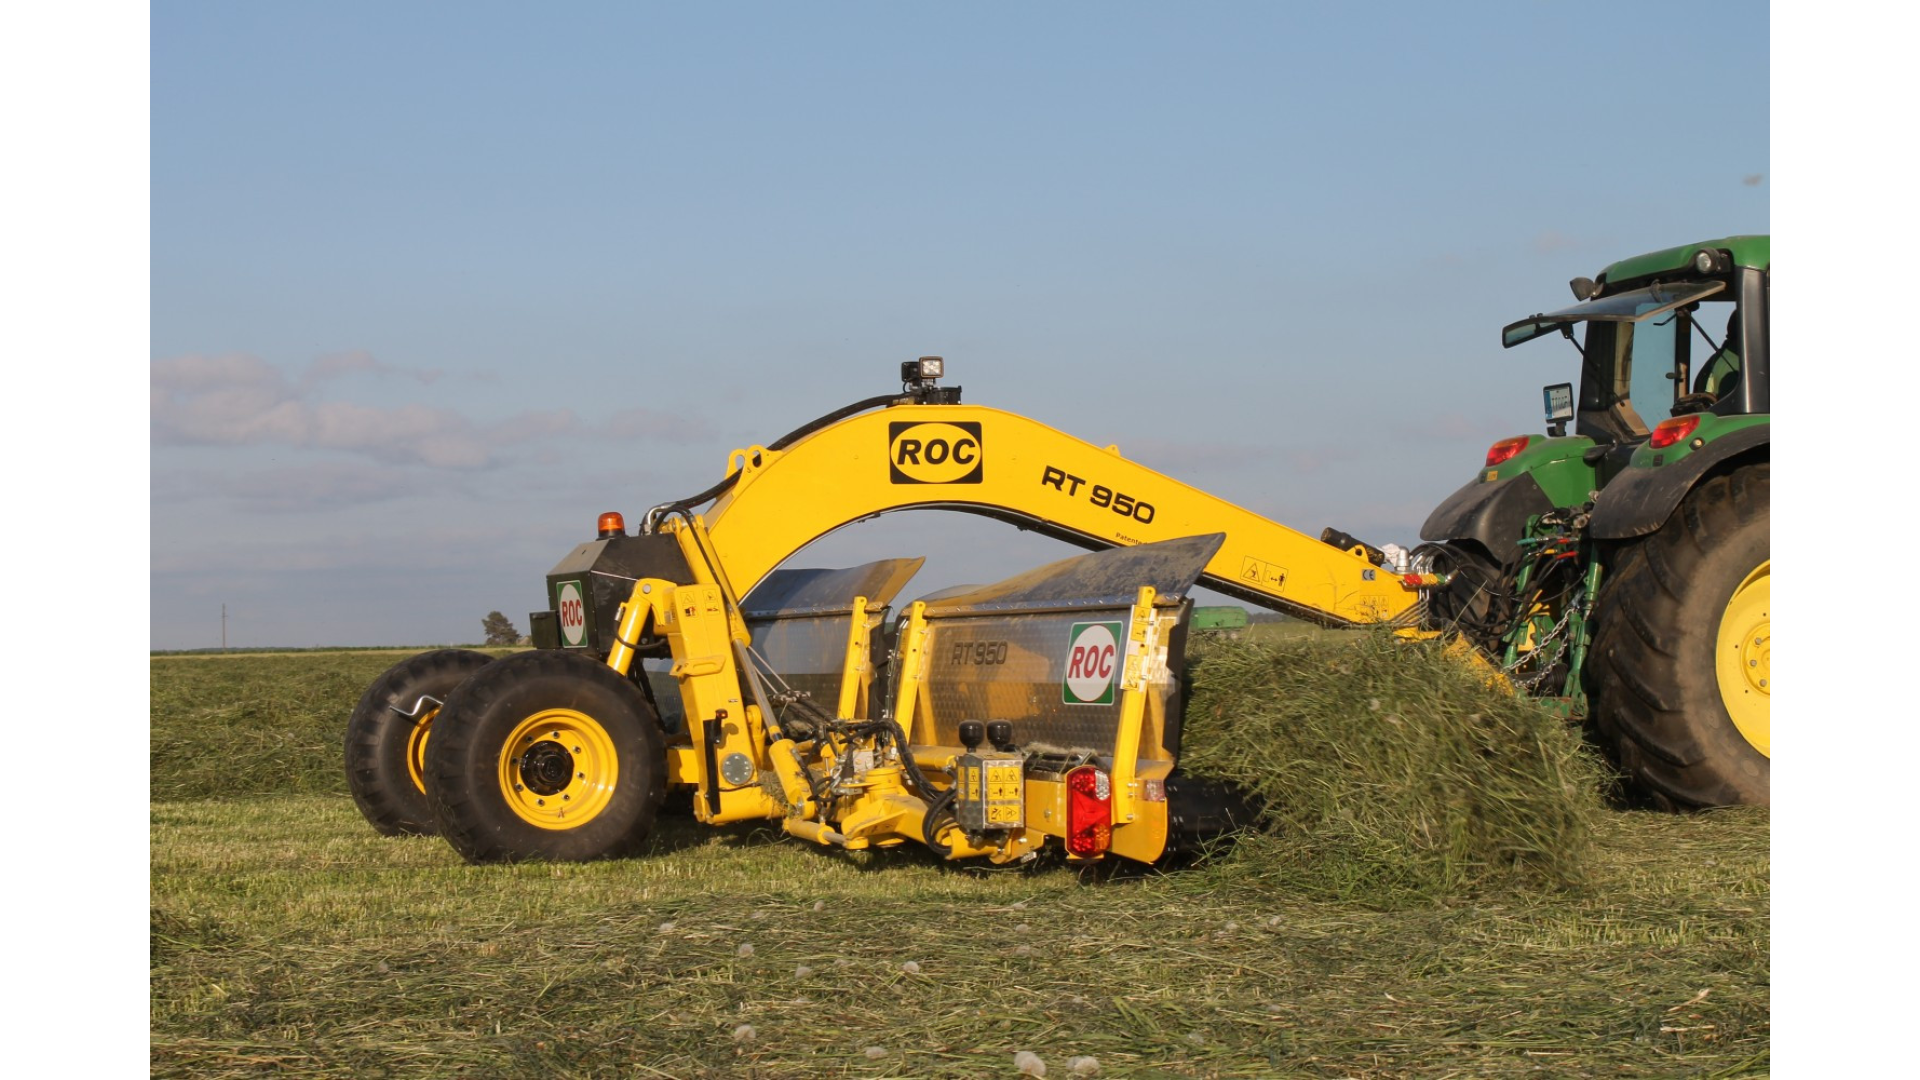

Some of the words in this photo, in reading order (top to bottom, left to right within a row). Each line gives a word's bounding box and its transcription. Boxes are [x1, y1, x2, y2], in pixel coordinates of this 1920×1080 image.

[897, 438, 976, 465] ROC
[1041, 465, 1086, 497] RT
[1089, 484, 1155, 525] 950
[562, 599, 583, 627] ROC
[951, 642, 974, 665] RT
[974, 641, 1008, 665] 950
[1068, 644, 1114, 679] ROC
